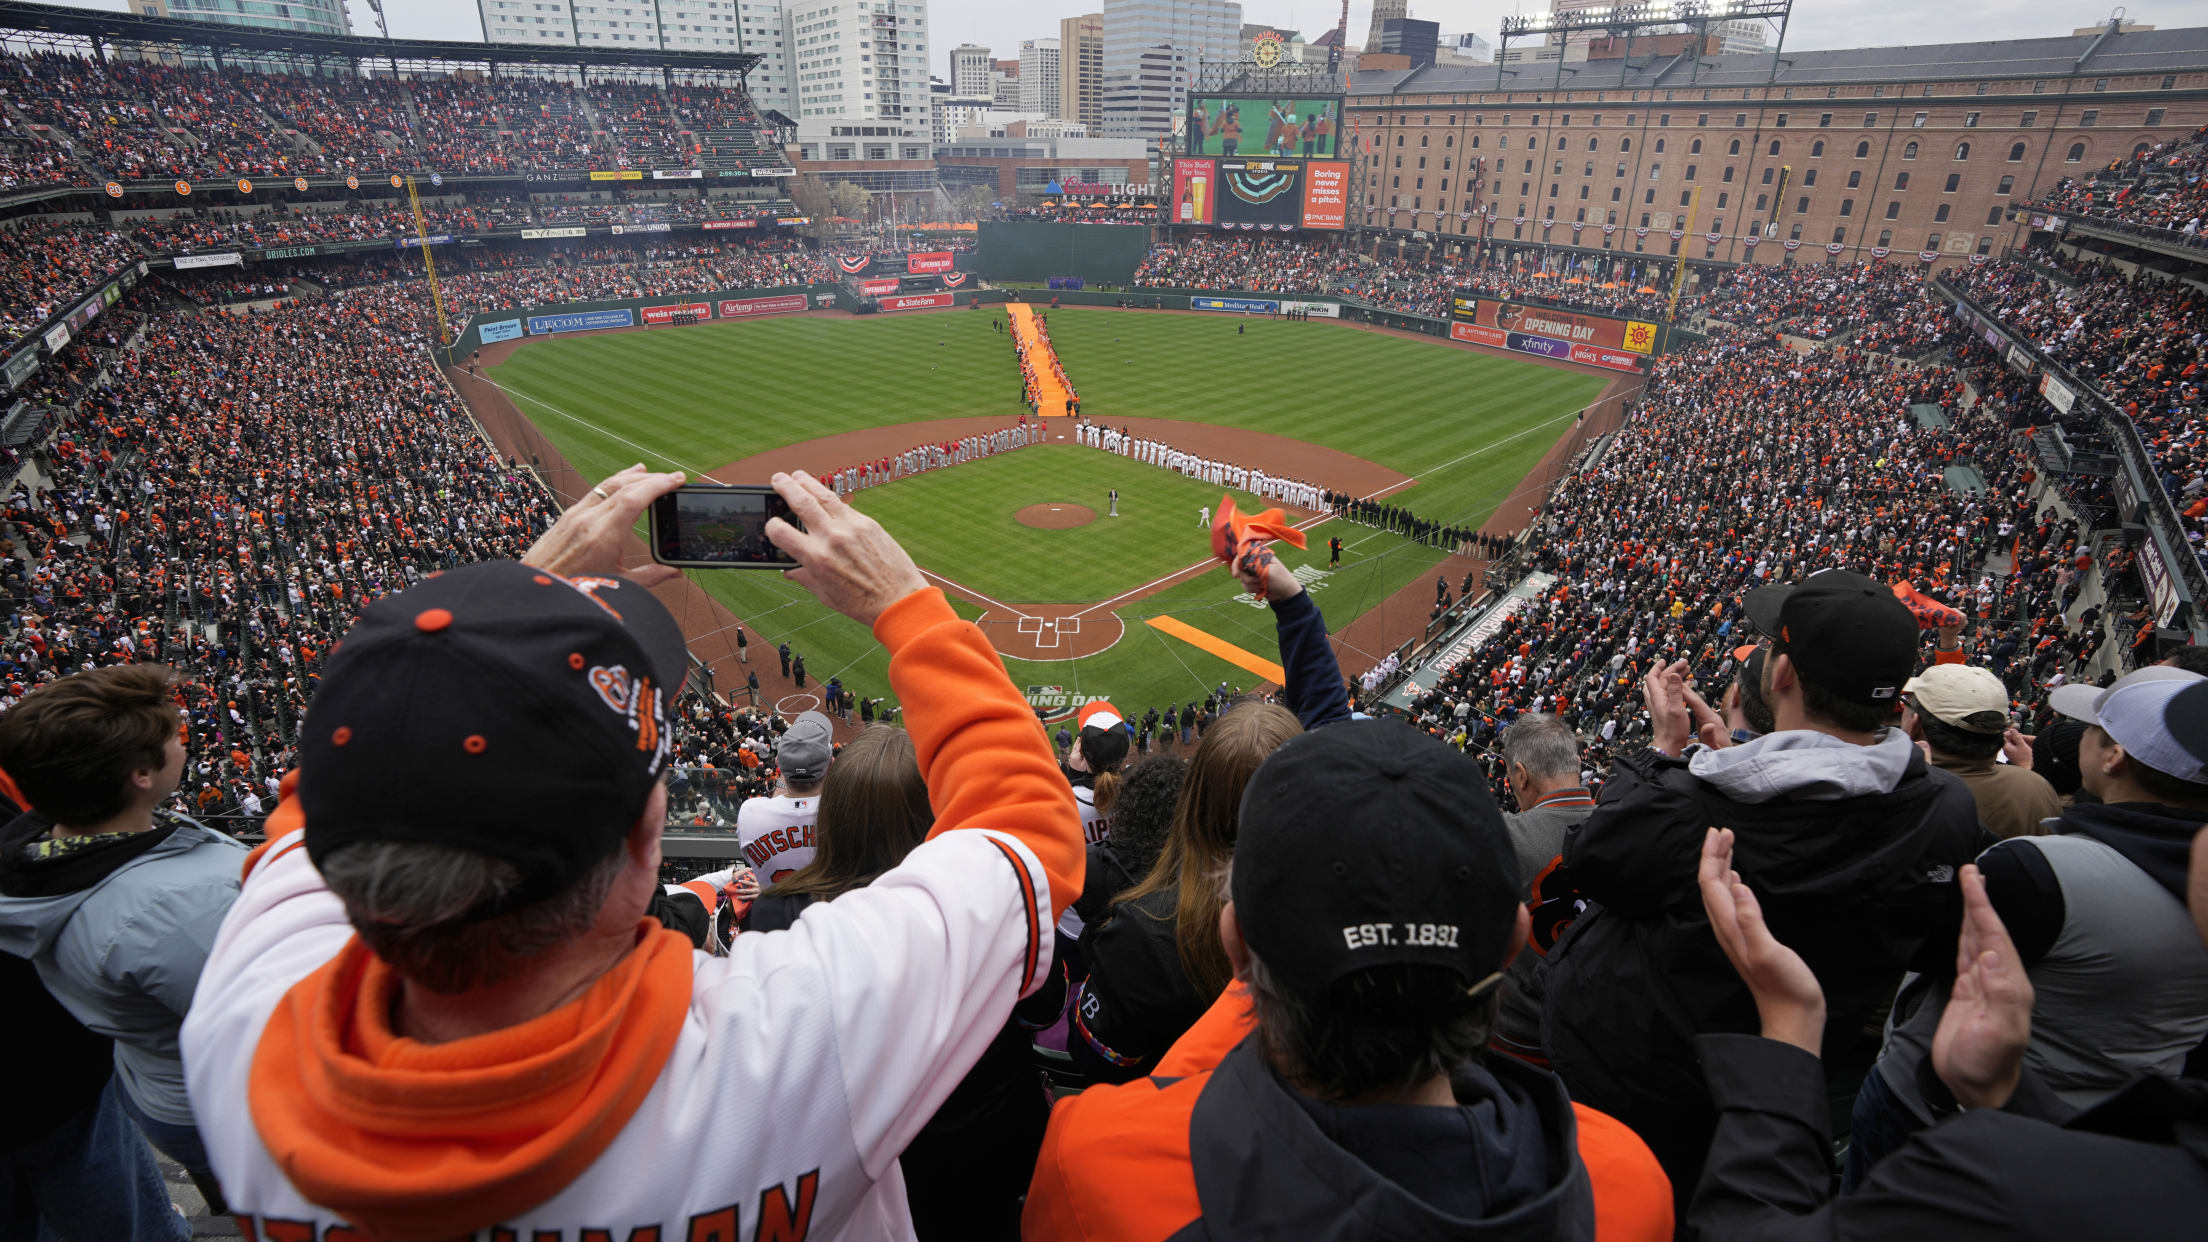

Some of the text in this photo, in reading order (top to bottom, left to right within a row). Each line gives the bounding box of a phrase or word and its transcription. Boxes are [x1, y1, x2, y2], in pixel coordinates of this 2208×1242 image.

[527, 173, 558, 181] GANZ
[1314, 170, 1341, 178] Boring
[296, 180, 307, 188] 22
[348, 178, 358, 187] 33
[1064, 176, 1157, 196] Coors LIGHT
[109, 185, 121, 194] 20
[1312, 187, 1339, 195] misses
[1318, 196, 1341, 205] pitch.
[266, 247, 315, 260] ORIOLES.COM
[725, 303, 753, 313] Airtemp
[1536, 311, 1586, 326] WELCOME TO
[1467, 328, 1488, 336] AUTUMN
[1525, 318, 1595, 341] OPENING DAY
[1522, 336, 1554, 352] xfinity
[1343, 923, 1459, 950] EST. 1831
